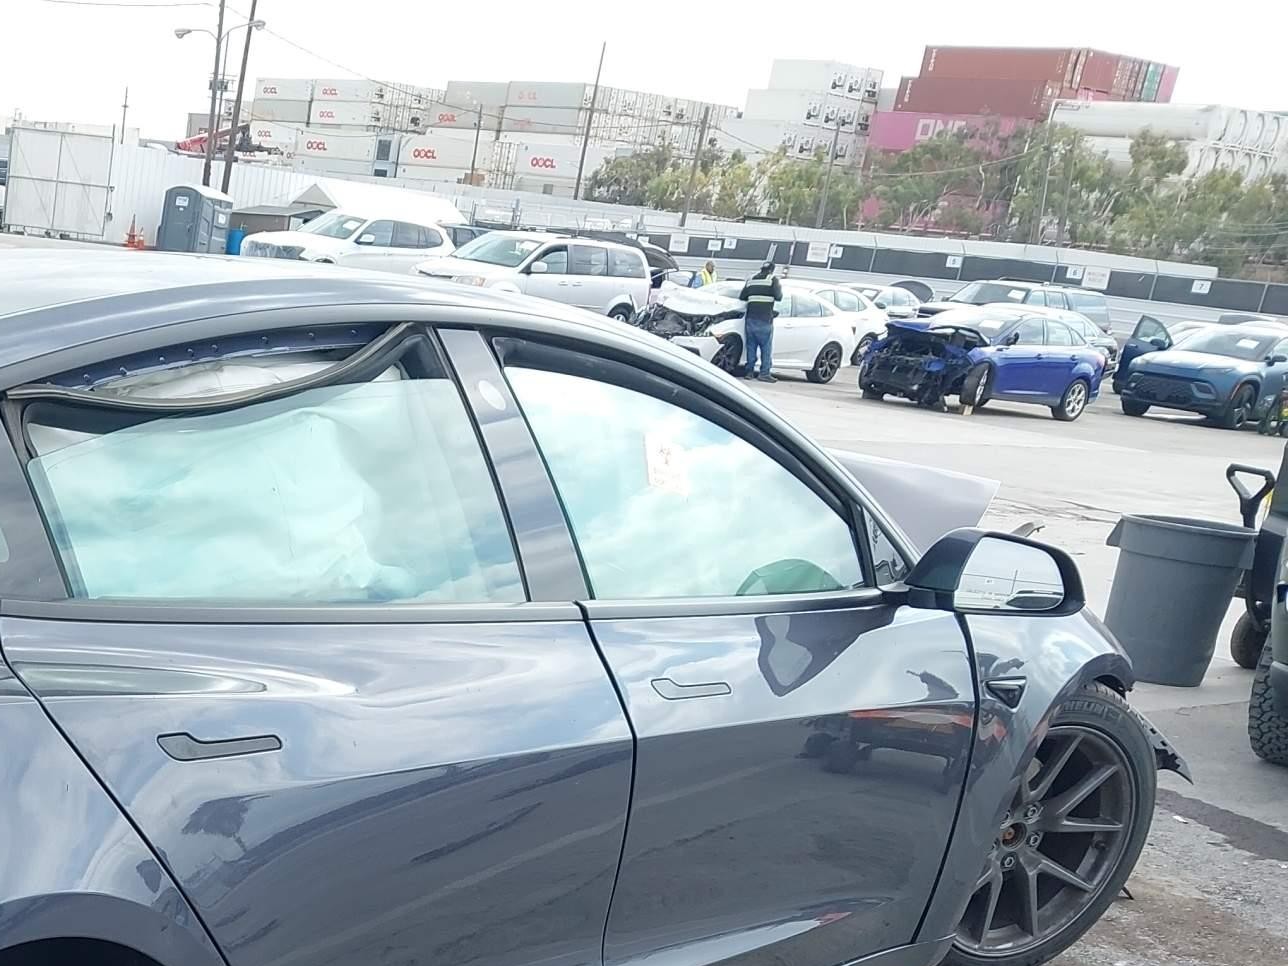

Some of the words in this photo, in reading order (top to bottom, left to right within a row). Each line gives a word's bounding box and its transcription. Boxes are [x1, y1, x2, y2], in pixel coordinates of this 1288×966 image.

[306, 140, 328, 151] OOCL
[413, 148, 437, 160] OOCL
[530, 157, 556, 169] OOCL
